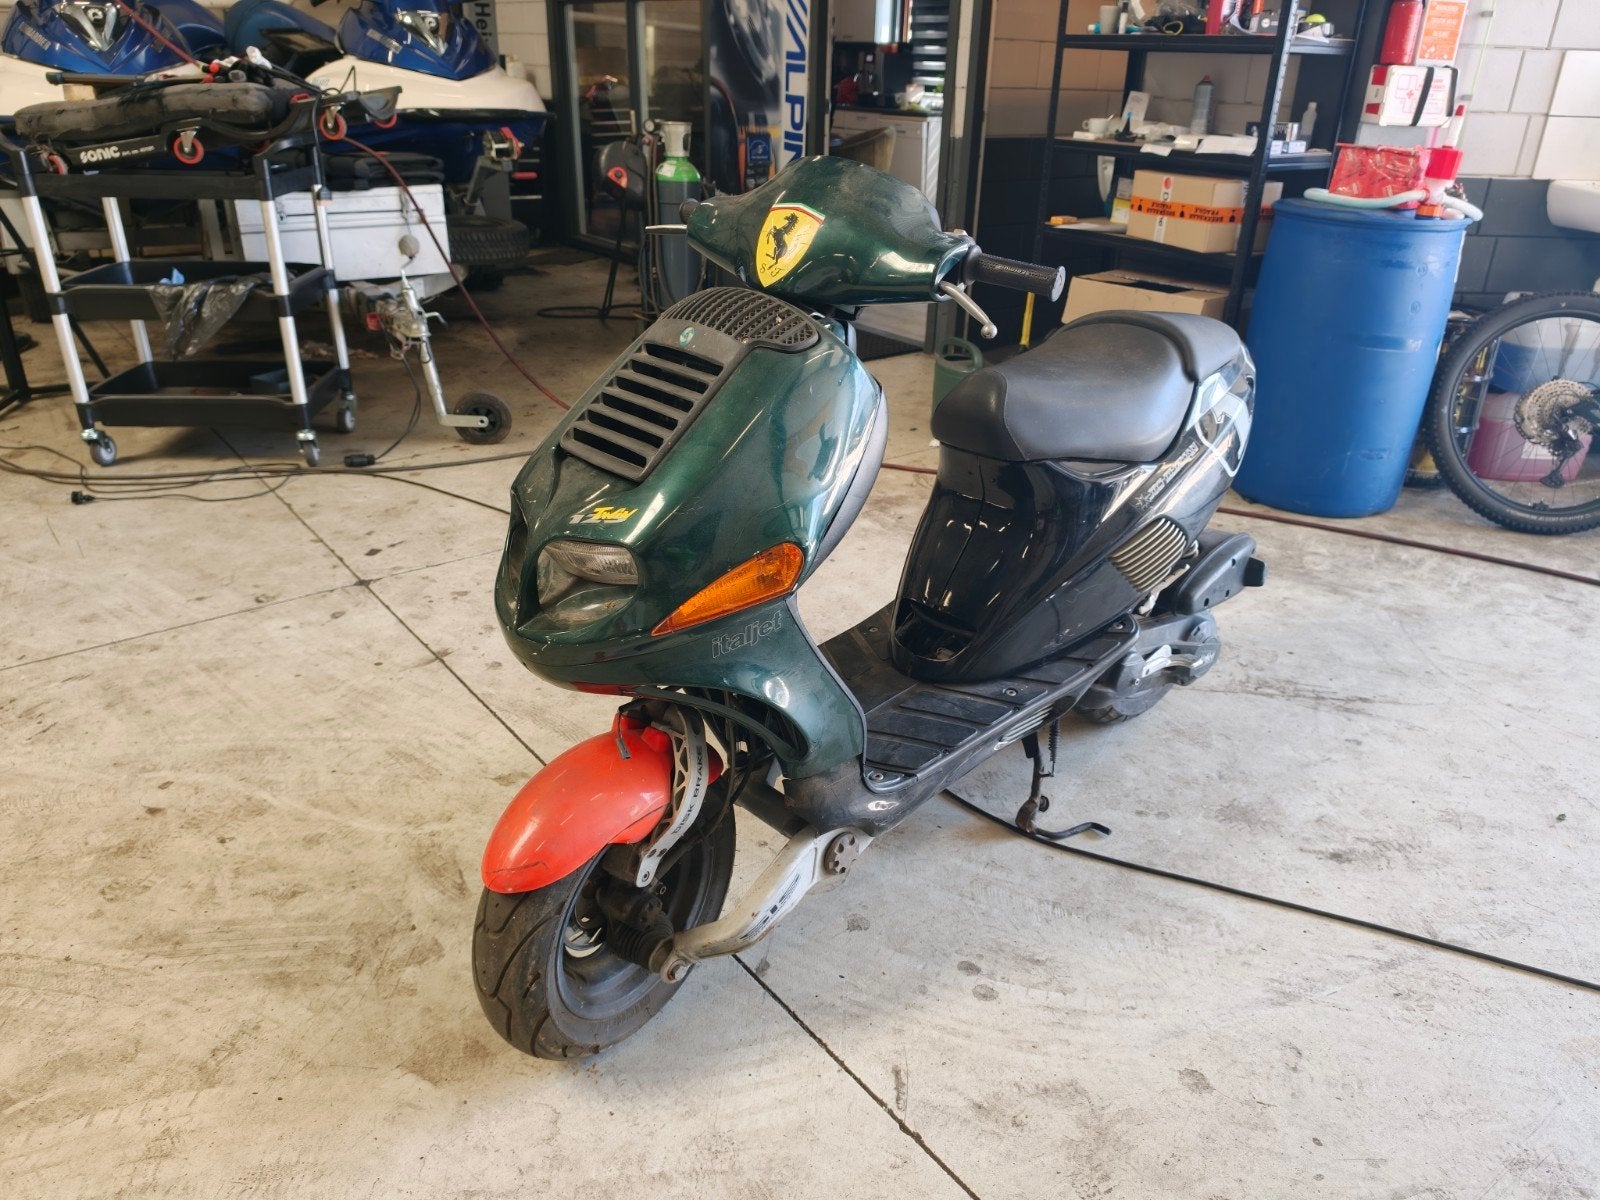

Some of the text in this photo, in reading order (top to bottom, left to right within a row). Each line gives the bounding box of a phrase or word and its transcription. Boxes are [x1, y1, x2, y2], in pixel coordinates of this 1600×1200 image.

[474, 2, 492, 42] Hei
[711, 609, 782, 659] italjet
[671, 745, 703, 835] DISK BRAKE
